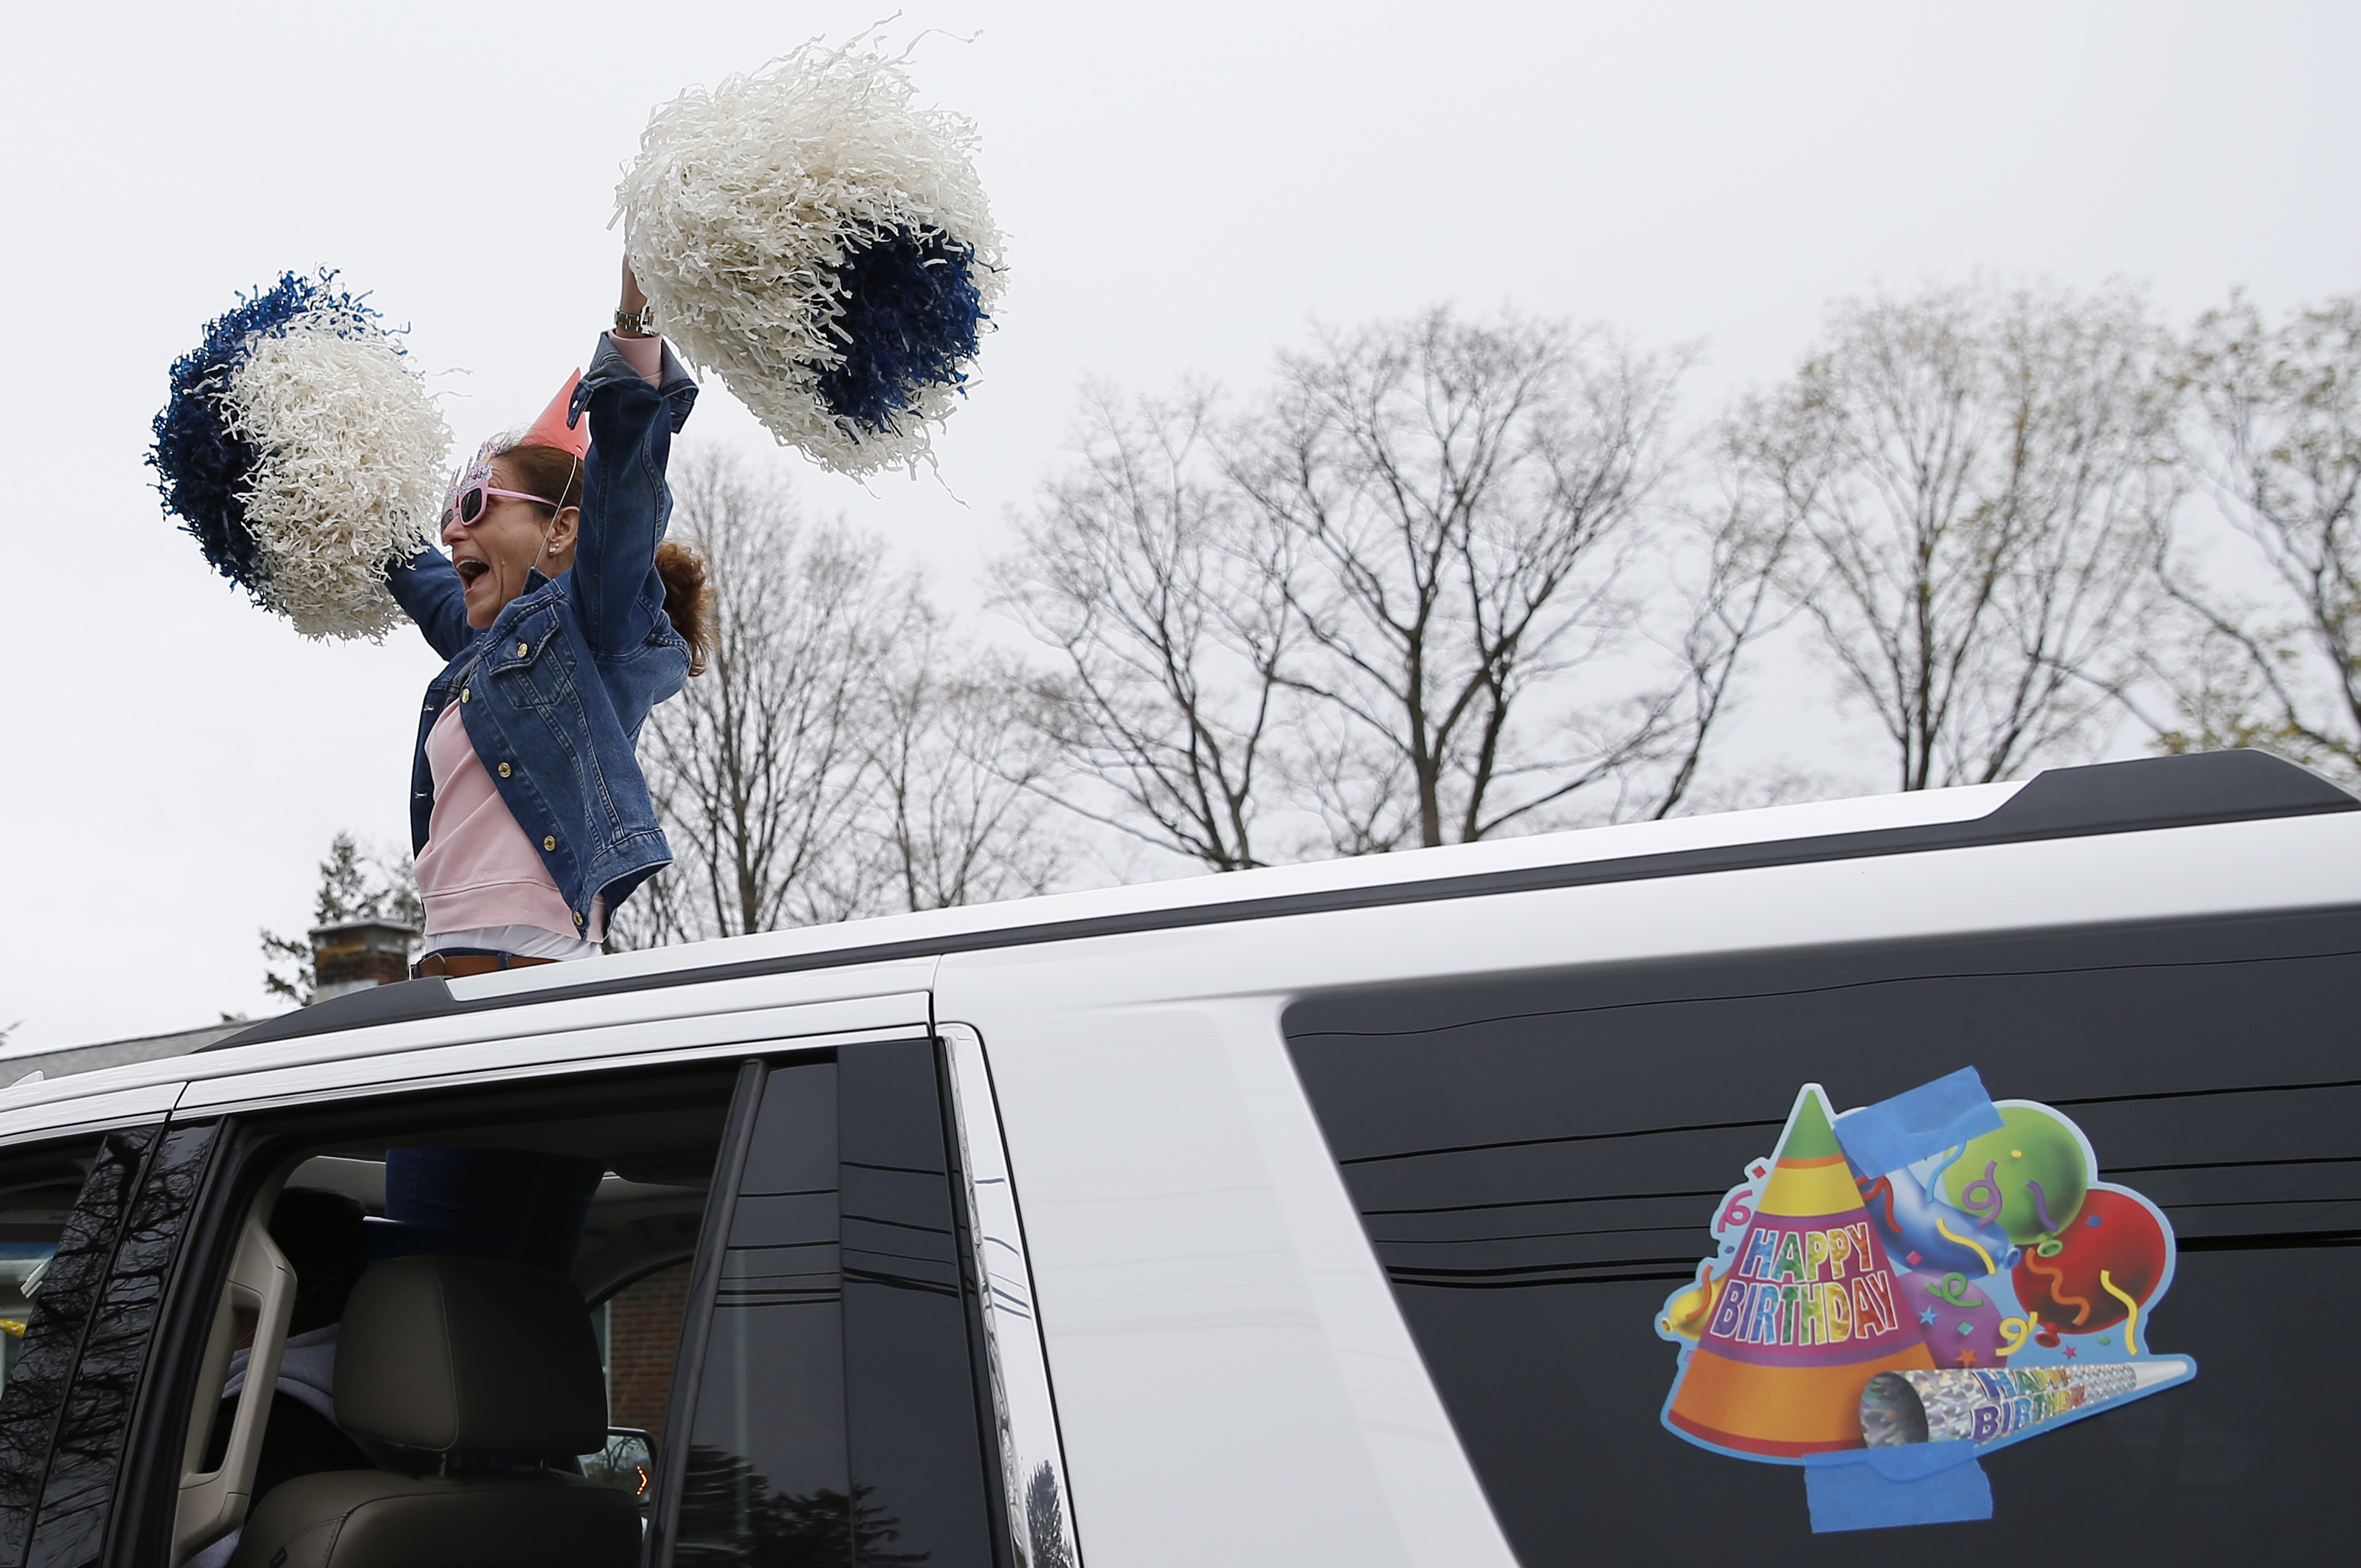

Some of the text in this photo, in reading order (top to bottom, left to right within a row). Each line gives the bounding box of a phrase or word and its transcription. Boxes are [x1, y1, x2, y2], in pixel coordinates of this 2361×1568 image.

[1738, 1221, 1873, 1282] HAPPY
[1710, 1270, 1898, 1346] BIRTHDAY
[1972, 1368, 2070, 1401] HAPPY
